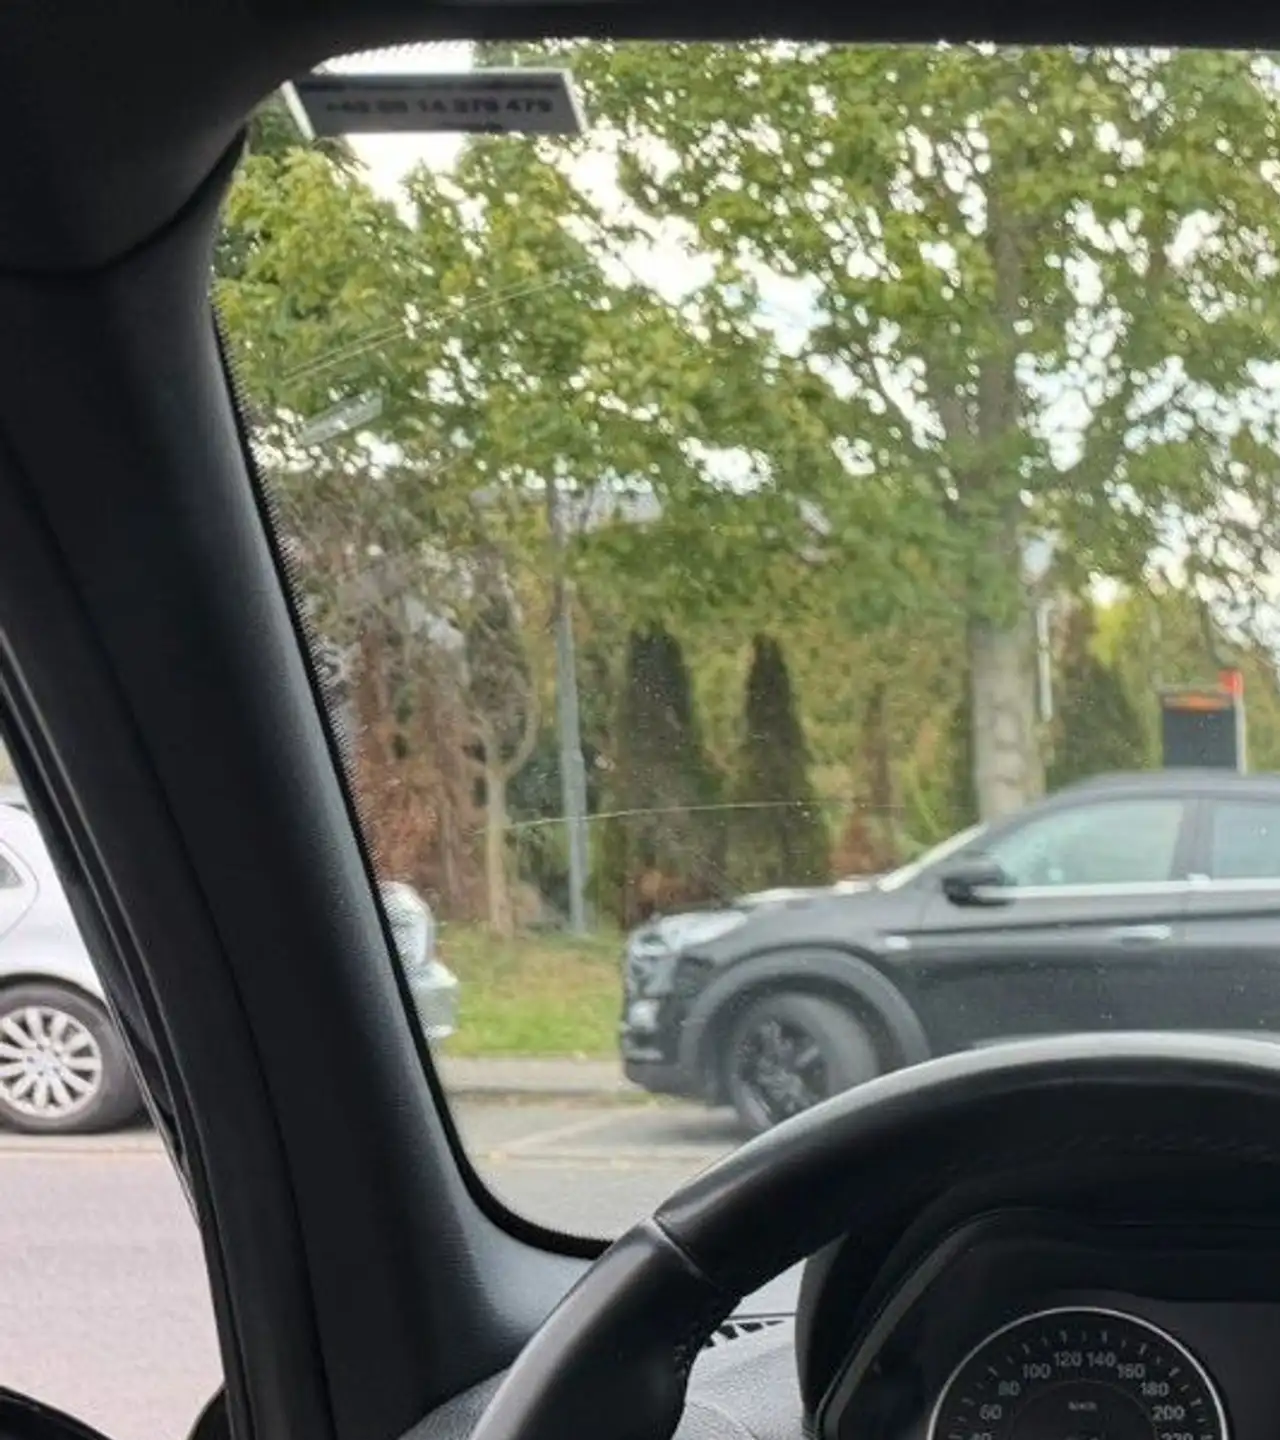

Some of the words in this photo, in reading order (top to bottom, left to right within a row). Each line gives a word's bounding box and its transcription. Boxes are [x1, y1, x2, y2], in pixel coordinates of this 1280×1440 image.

[1053, 1351, 1082, 1367] 120
[1086, 1352, 1116, 1368] 140
[1022, 1363, 1052, 1379] 100
[1117, 1363, 1146, 1379] 160
[1140, 1381, 1170, 1397] 180
[979, 1404, 1003, 1420] 60
[1152, 1405, 1185, 1421] 200
